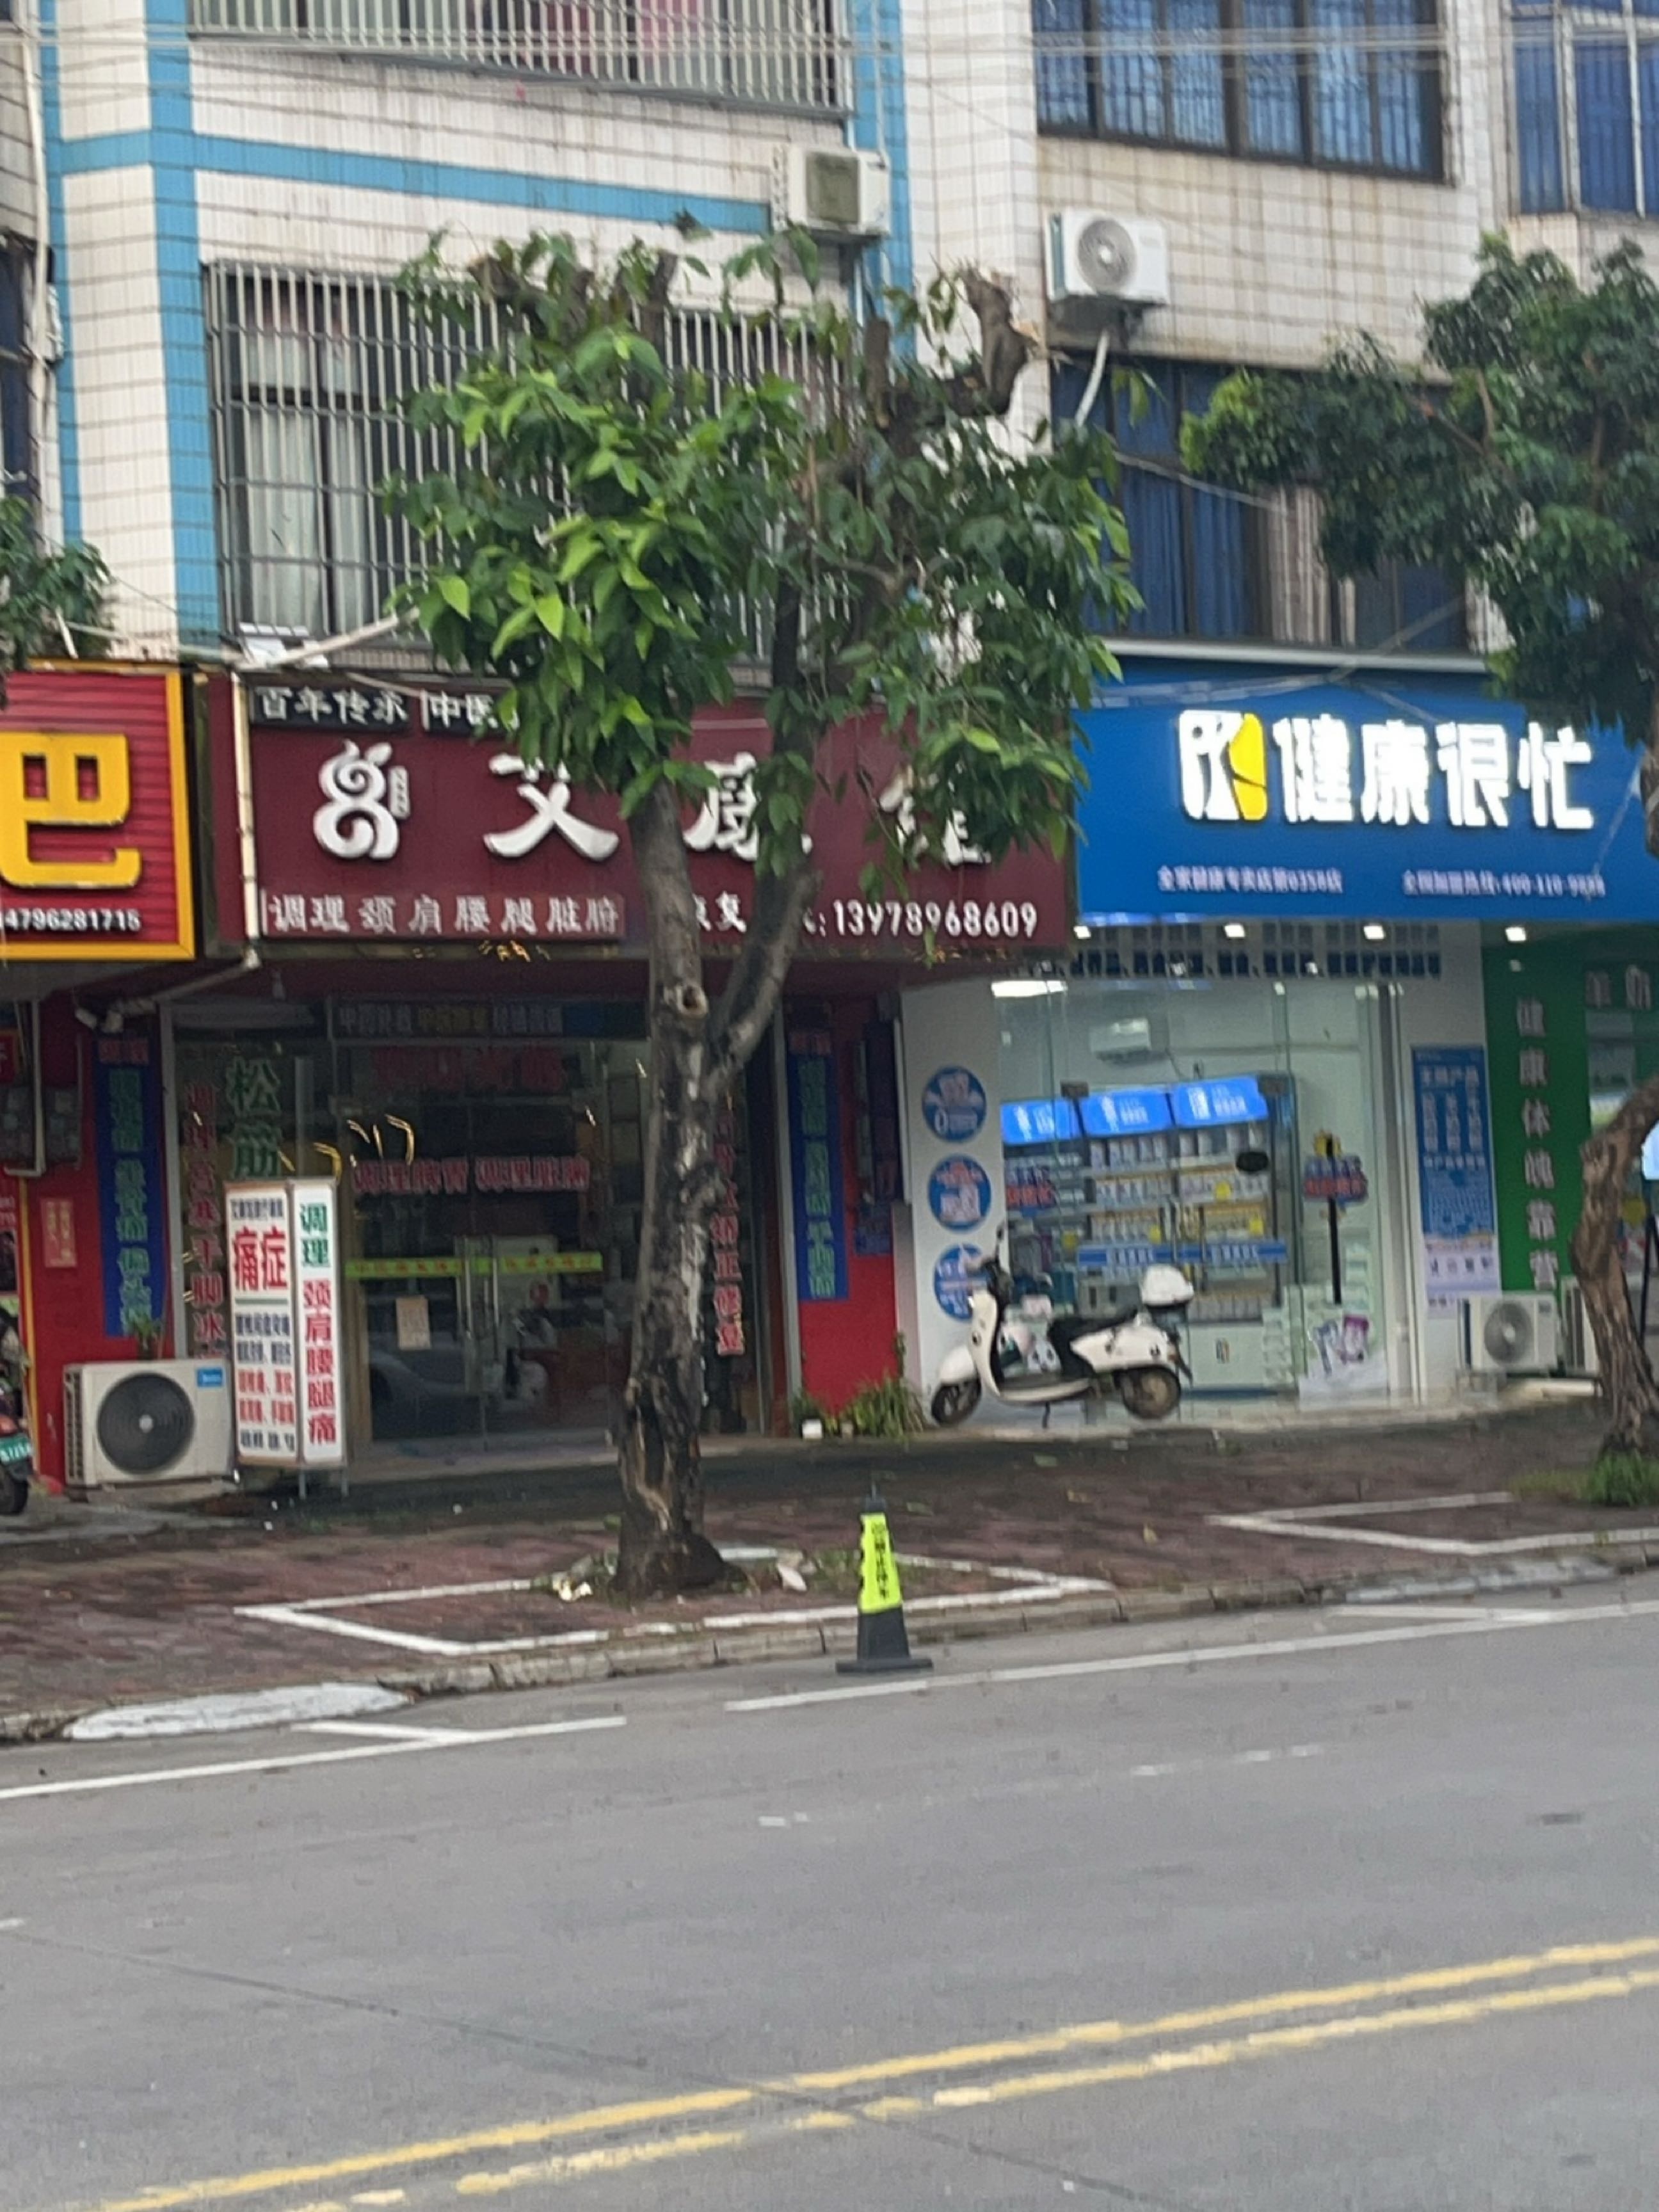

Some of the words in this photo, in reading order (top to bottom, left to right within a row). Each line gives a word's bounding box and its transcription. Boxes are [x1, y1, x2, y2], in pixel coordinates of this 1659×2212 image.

[257, 686, 408, 725] 百年传承
[429, 691, 520, 731] 中医
[1272, 714, 1594, 830] 健康很忙
[0, 732, 142, 888] 巴
[833, 899, 1038, 938] 13978968609
[232, 1225, 288, 1292] 痛症
